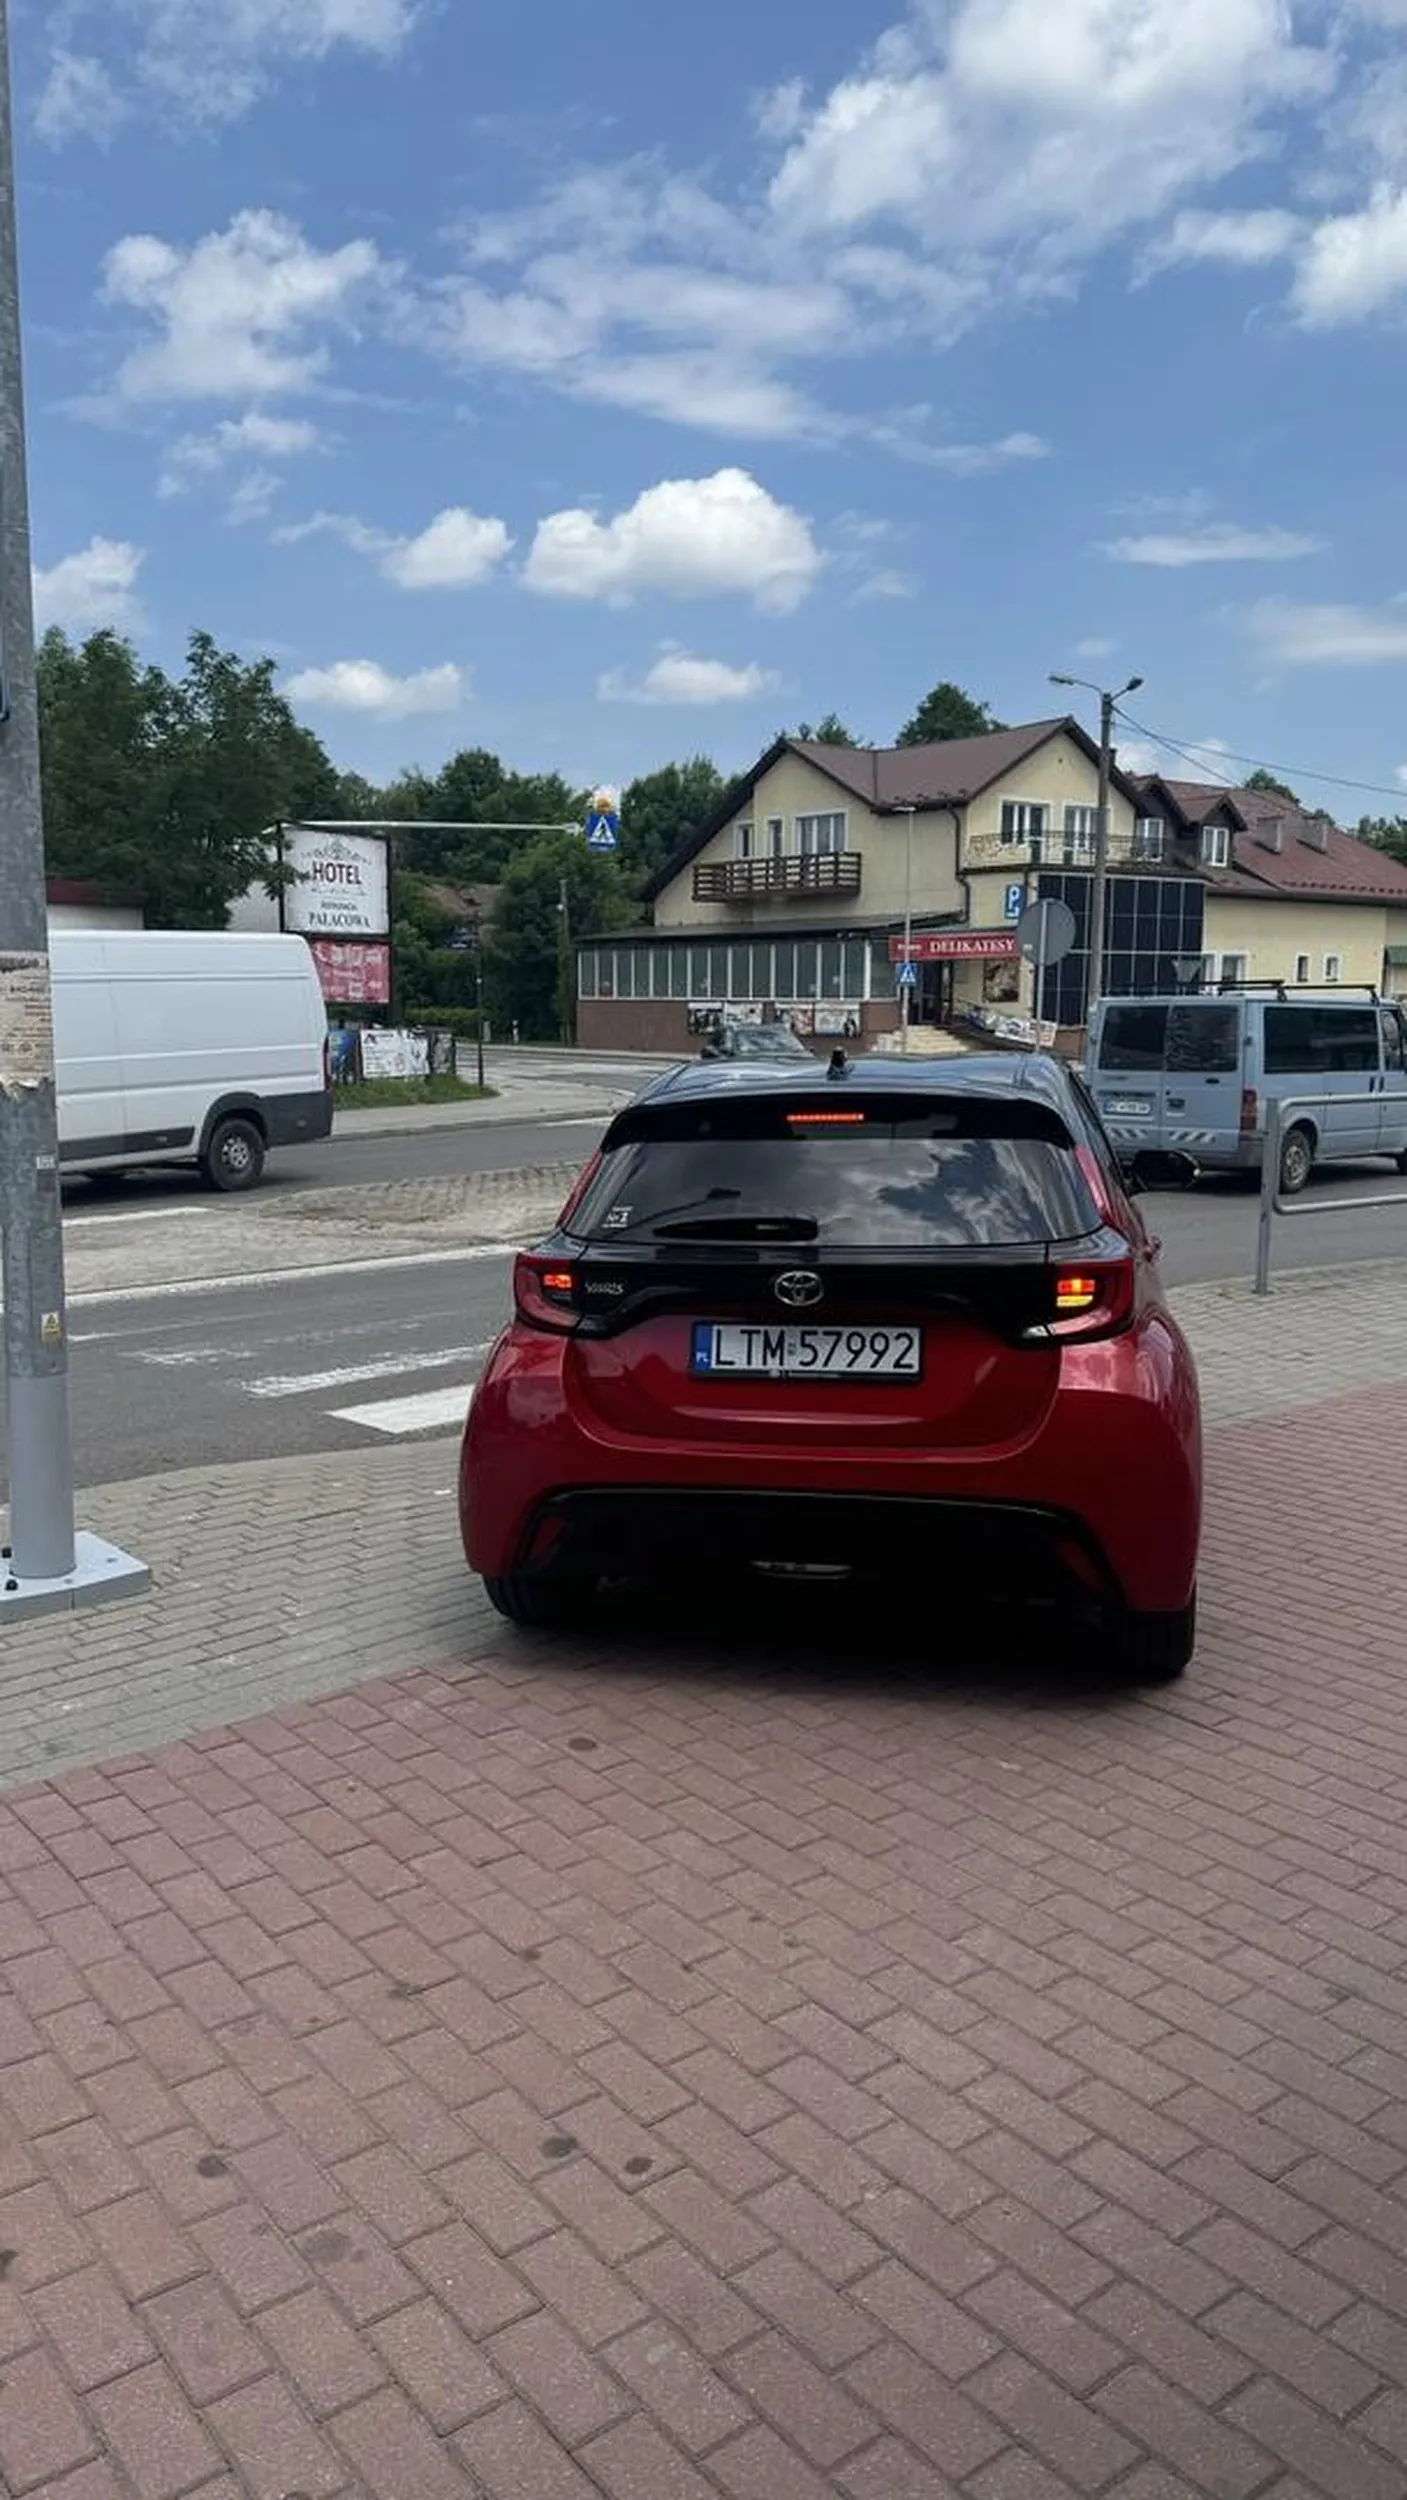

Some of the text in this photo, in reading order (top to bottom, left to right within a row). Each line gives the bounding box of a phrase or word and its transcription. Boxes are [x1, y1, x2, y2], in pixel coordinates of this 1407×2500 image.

[312, 861, 362, 885] HOTEL
[928, 938, 1015, 954] DELIKATESY
[715, 1328, 914, 1370] LTM 57992
